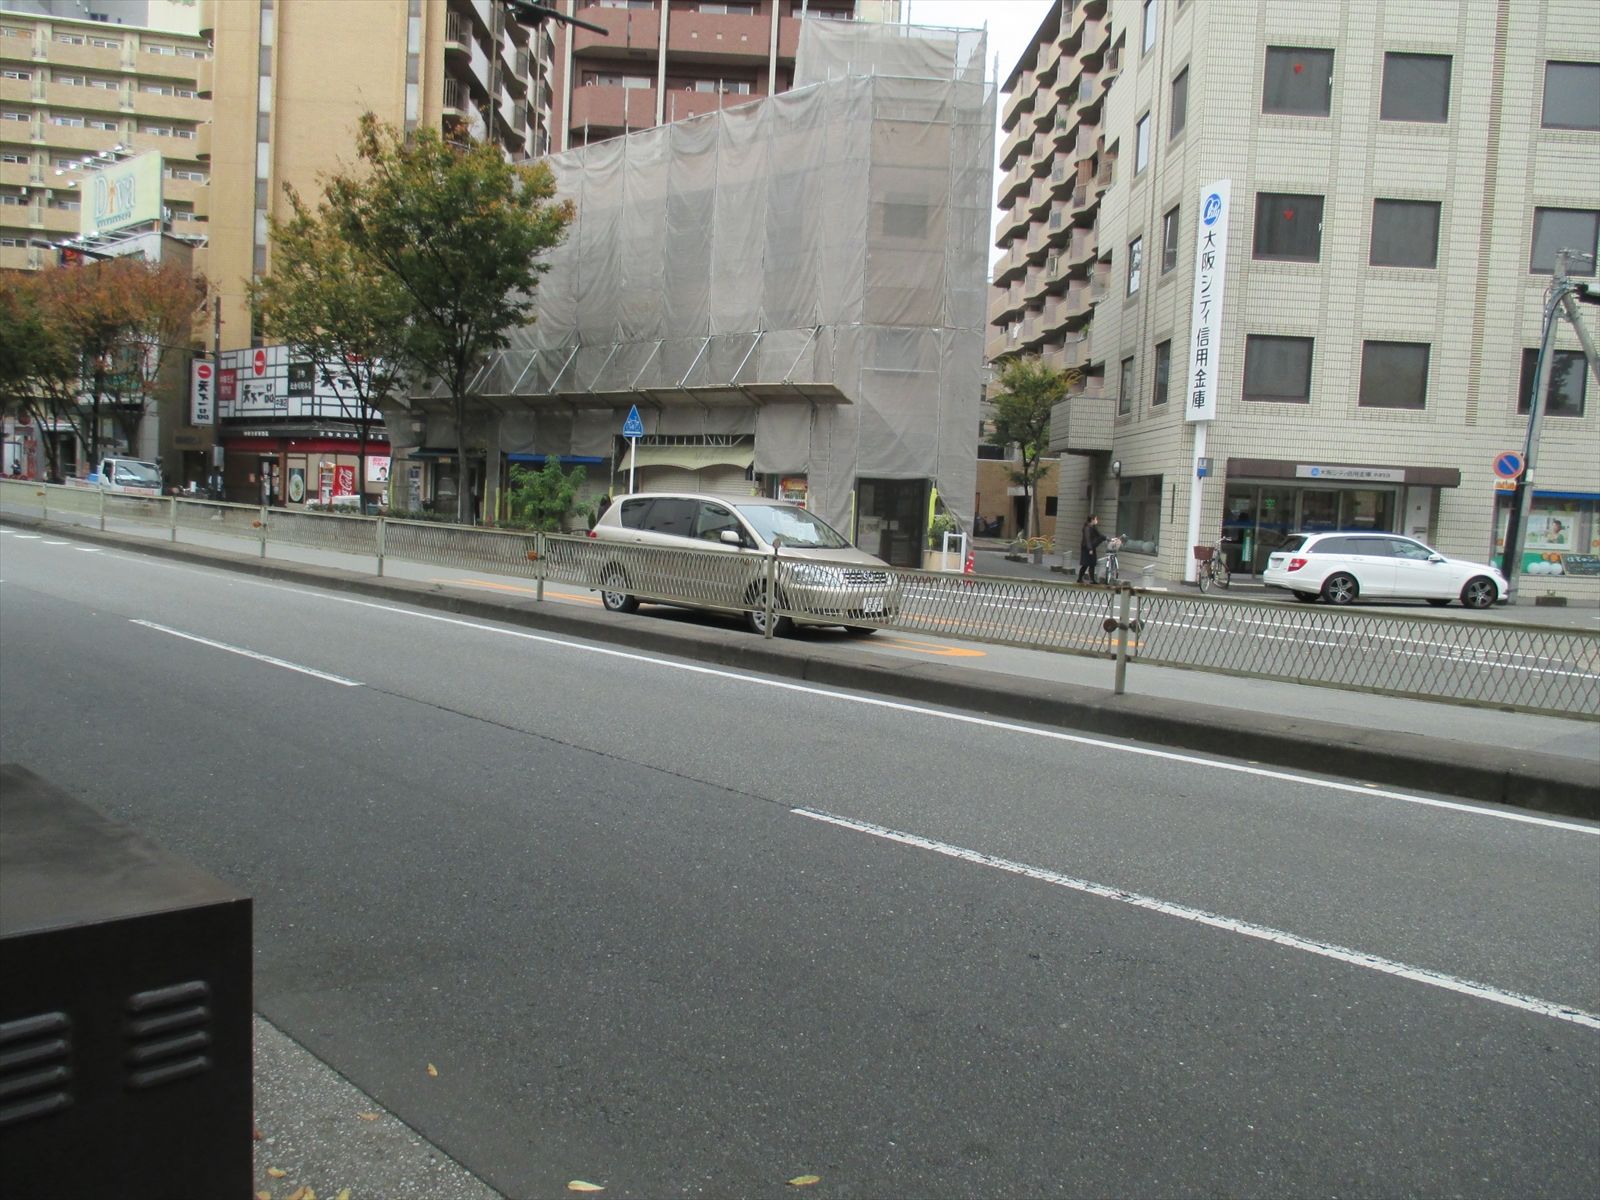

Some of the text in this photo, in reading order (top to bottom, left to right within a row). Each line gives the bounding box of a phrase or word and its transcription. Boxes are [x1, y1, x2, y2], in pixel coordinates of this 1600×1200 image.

[1191, 230, 1217, 408] 大阪シティ信用金庫
[197, 381, 210, 420] 天下一品
